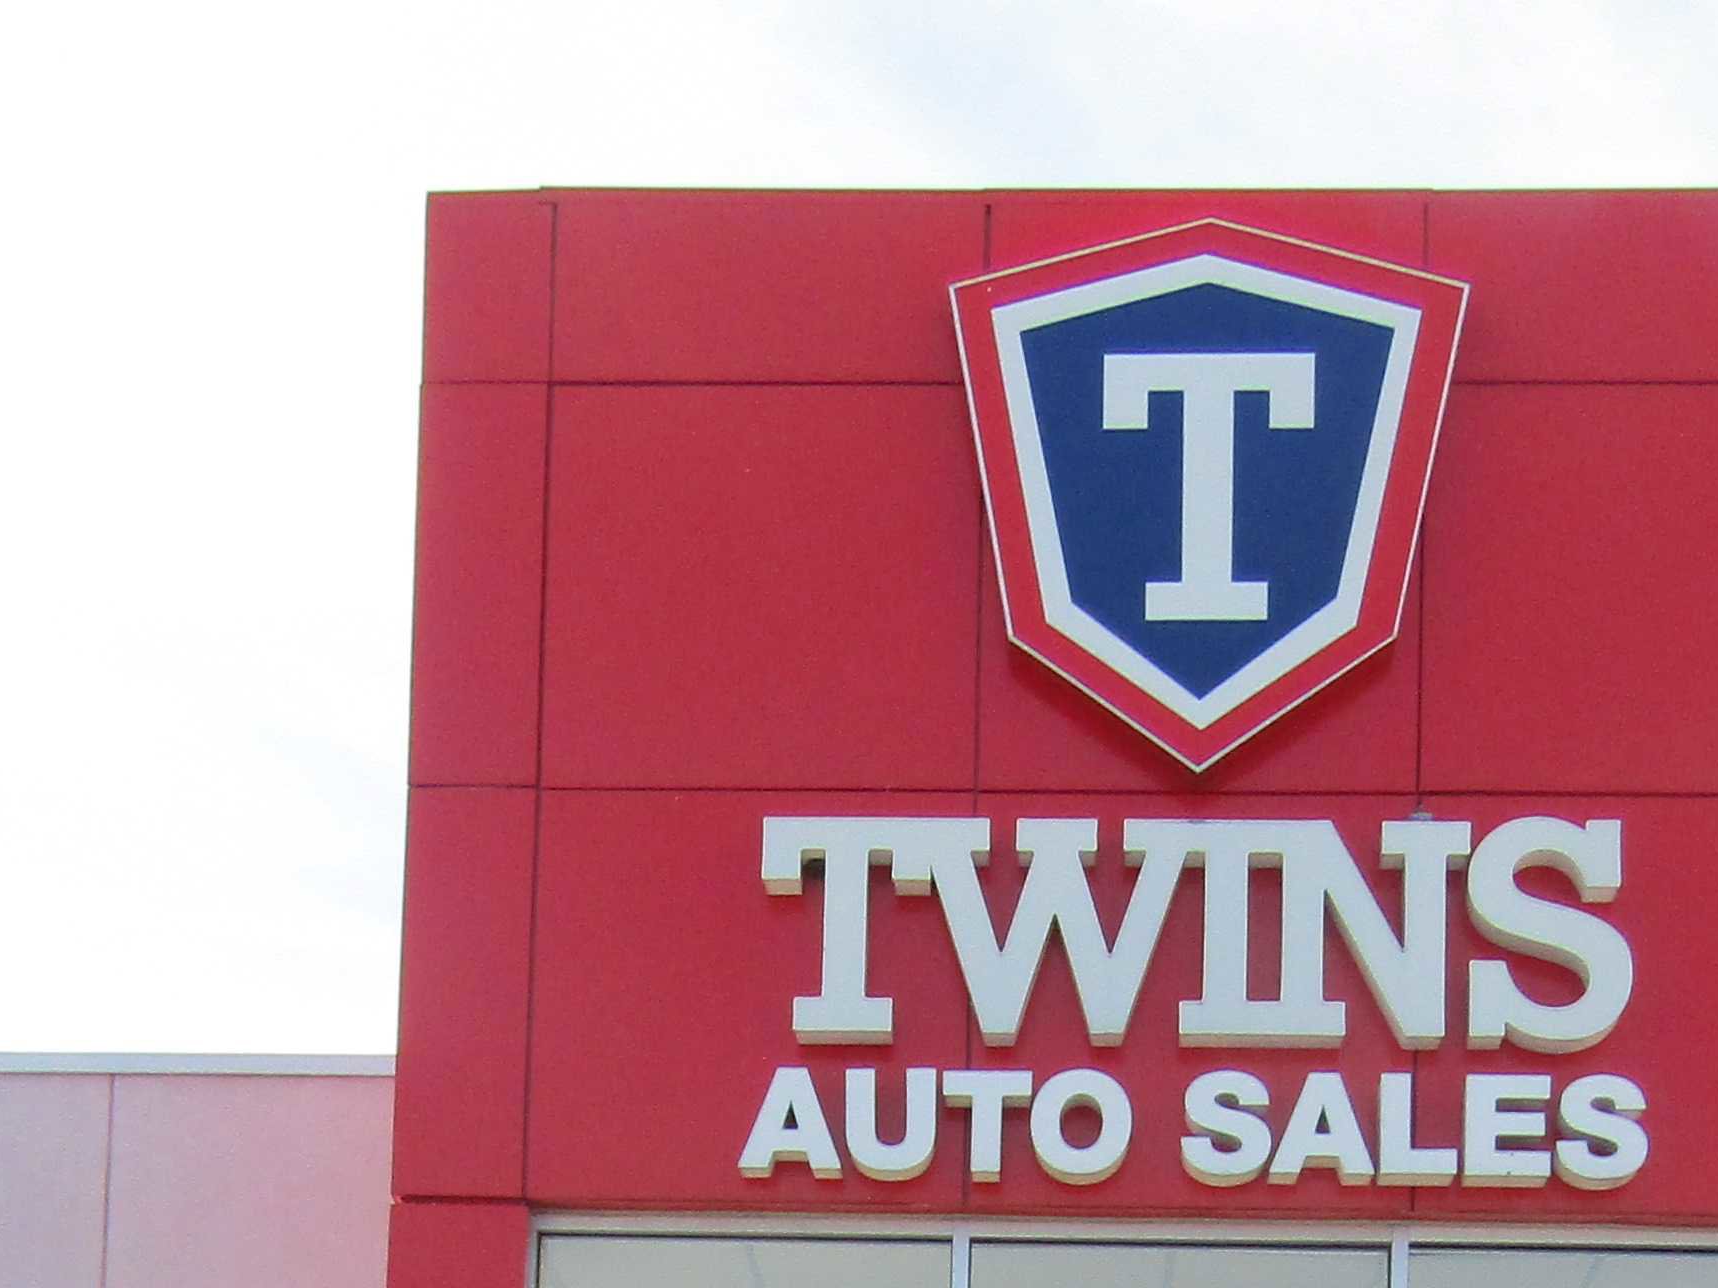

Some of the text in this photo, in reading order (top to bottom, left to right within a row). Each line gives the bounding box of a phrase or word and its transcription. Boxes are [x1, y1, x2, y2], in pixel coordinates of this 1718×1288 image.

[1102, 352, 1316, 621] T
[761, 815, 1634, 1054] TWINS
[738, 1066, 1650, 1190] AUTO SALES
